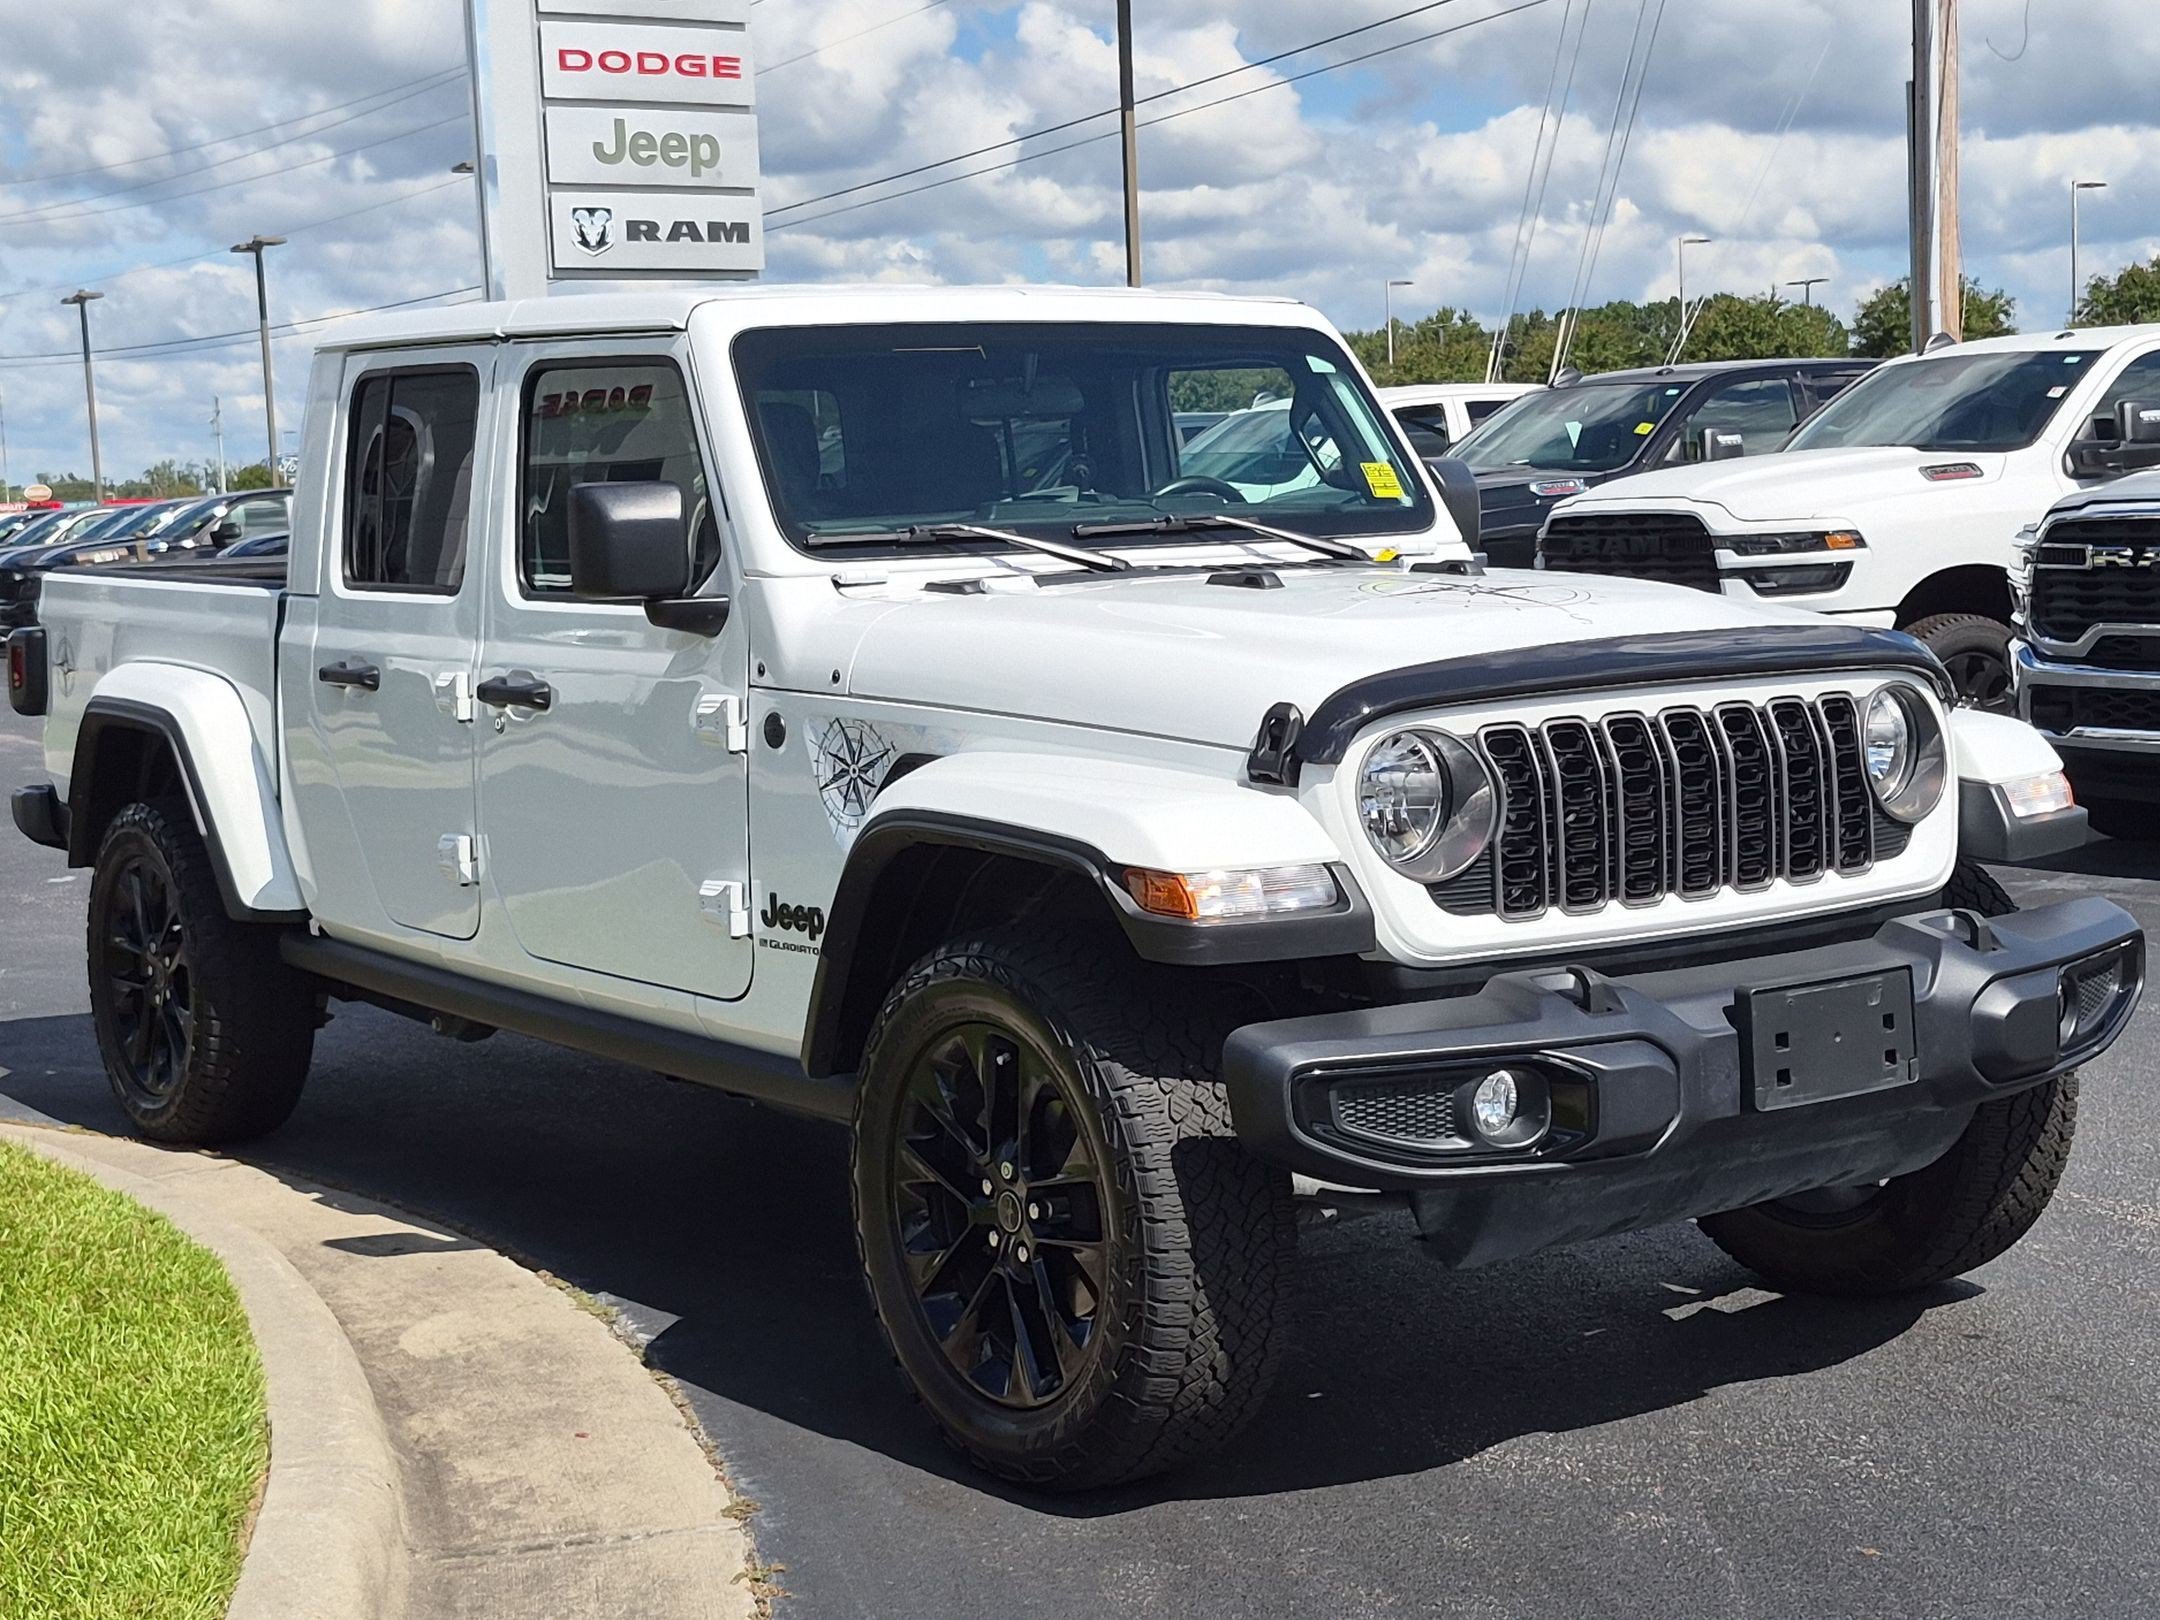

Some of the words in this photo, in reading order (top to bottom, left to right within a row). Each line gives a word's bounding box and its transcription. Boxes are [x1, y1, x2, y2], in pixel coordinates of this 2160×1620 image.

[558, 49, 742, 79] DODGE
[592, 118, 720, 177] Jeep
[626, 219, 750, 243] RAM
[761, 892, 825, 940] Jeep
[769, 939, 820, 955] GLADIATO
